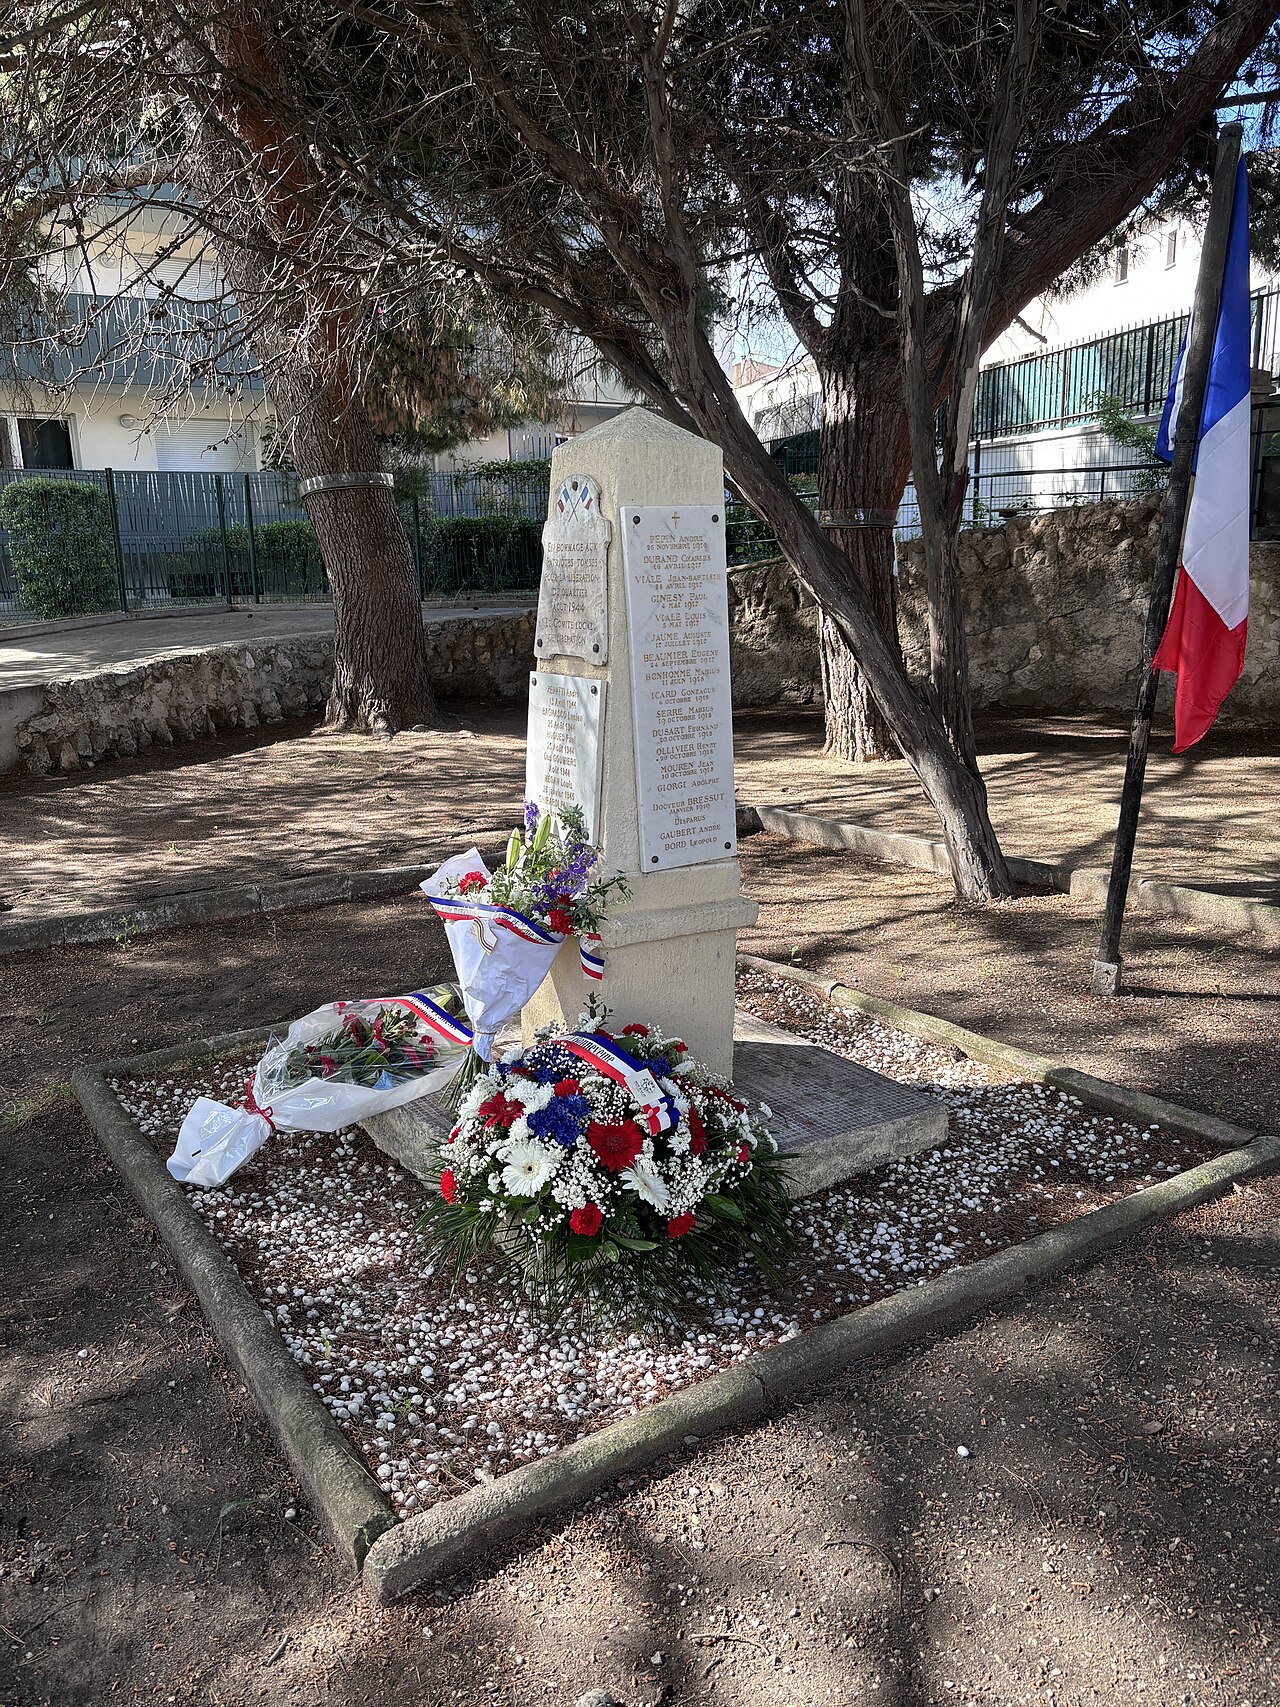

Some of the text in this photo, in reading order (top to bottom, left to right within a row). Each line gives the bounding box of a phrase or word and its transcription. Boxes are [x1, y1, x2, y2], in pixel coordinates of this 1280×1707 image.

[643, 555, 678, 563] DURAND
[635, 575, 662, 584] VIALE
[651, 593, 684, 603] GINESY
[568, 602, 585, 613] 1944
[684, 601, 699, 610] 1917
[655, 613, 680, 622] VIALE
[651, 633, 679, 641] JAUME
[664, 640, 690, 648] JUILLET
[643, 651, 688, 662] BEAUMIER
[661, 659, 697, 667] SEPTEMBRE
[646, 669, 691, 681] BONHOMME
[689, 676, 704, 685] 1918
[651, 690, 677, 700] ICARD
[695, 695, 710, 703] 1918
[656, 708, 683, 718] SERRE
[667, 714, 696, 722] OCTOBRE
[652, 726, 685, 737] DUSART
[669, 733, 695, 741] OCTOBRE
[698, 732, 713, 740] 1918
[656, 743, 694, 756] OLLIVIER
[670, 751, 697, 760] OCTOBRE
[699, 750, 714, 758] 1918
[660, 762, 694, 773] MOUREN
[670, 769, 697, 778] OCTOBRE
[700, 767, 714, 775] 1918
[657, 781, 686, 792] GIORGI
[687, 793, 726, 805] BRESSUT
[669, 803, 710, 815] JANVIER 1919
[660, 827, 697, 840] GAUBERT
[664, 840, 686, 851] BORD
